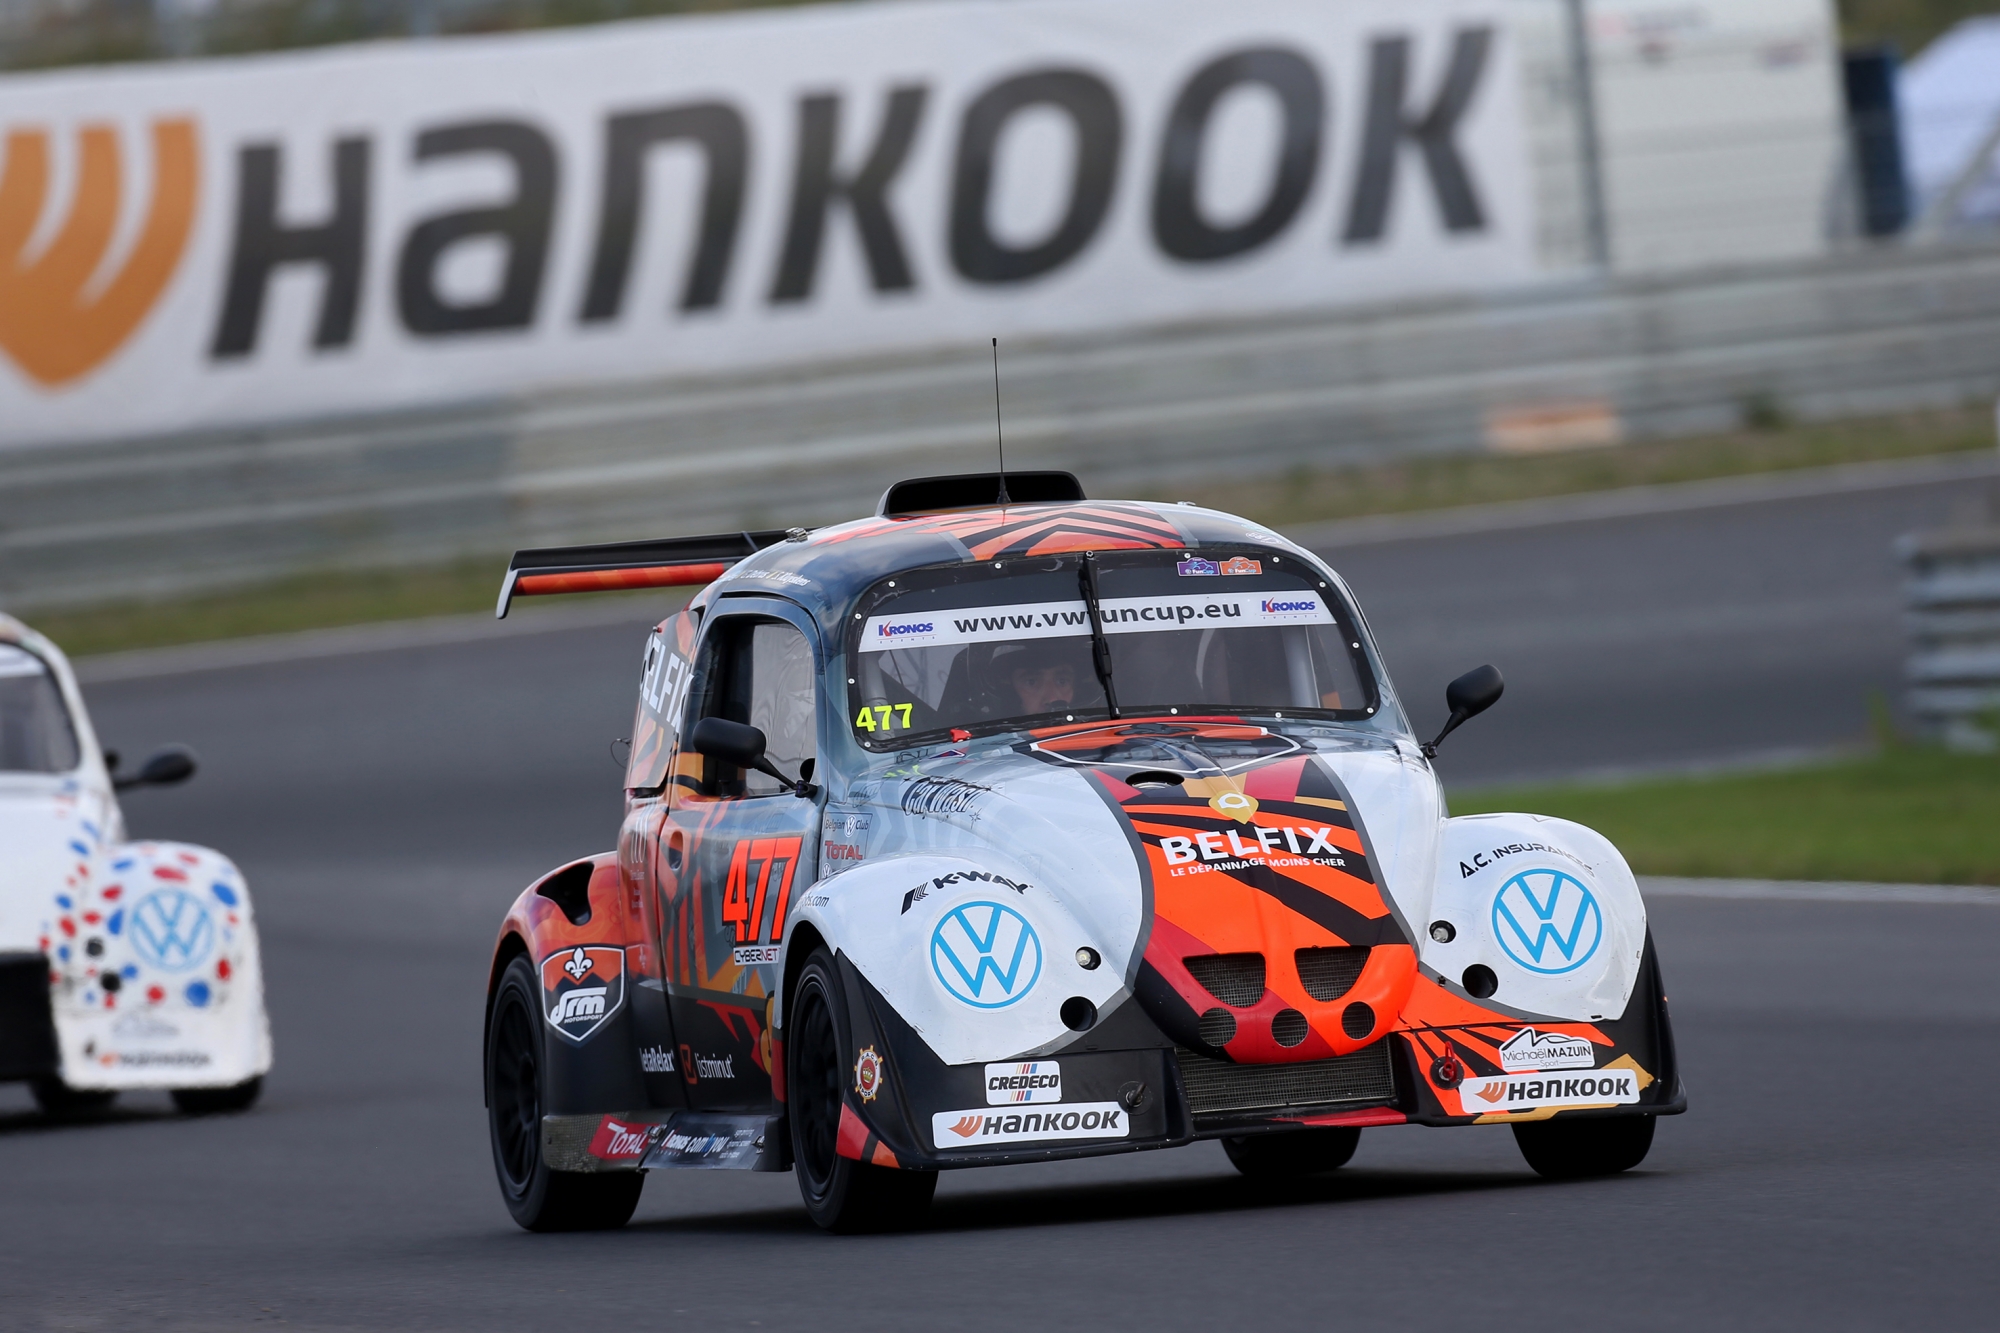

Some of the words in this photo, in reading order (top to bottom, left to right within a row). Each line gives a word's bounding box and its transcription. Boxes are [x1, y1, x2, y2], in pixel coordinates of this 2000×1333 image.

[1261, 596, 1316, 613] KRONOS
[878, 620, 934, 637] KRONOS
[954, 602, 1242, 633] www.vwuncup.eu
[641, 634, 694, 734] ELFIX
[856, 703, 913, 732] 477
[825, 840, 863, 860] TOTAL
[1159, 826, 1342, 866] BELFIX
[1170, 868, 1186, 877] LE
[1189, 857, 1267, 876] DÉPANNAGE
[1269, 857, 1310, 867] MOINS
[1310, 857, 1346, 867] CHER
[722, 836, 803, 944] 477
[735, 948, 778, 963] CYBERNET
[988, 1074, 1059, 1091] CREDECO
[607, 1121, 648, 1155] TOTAL
